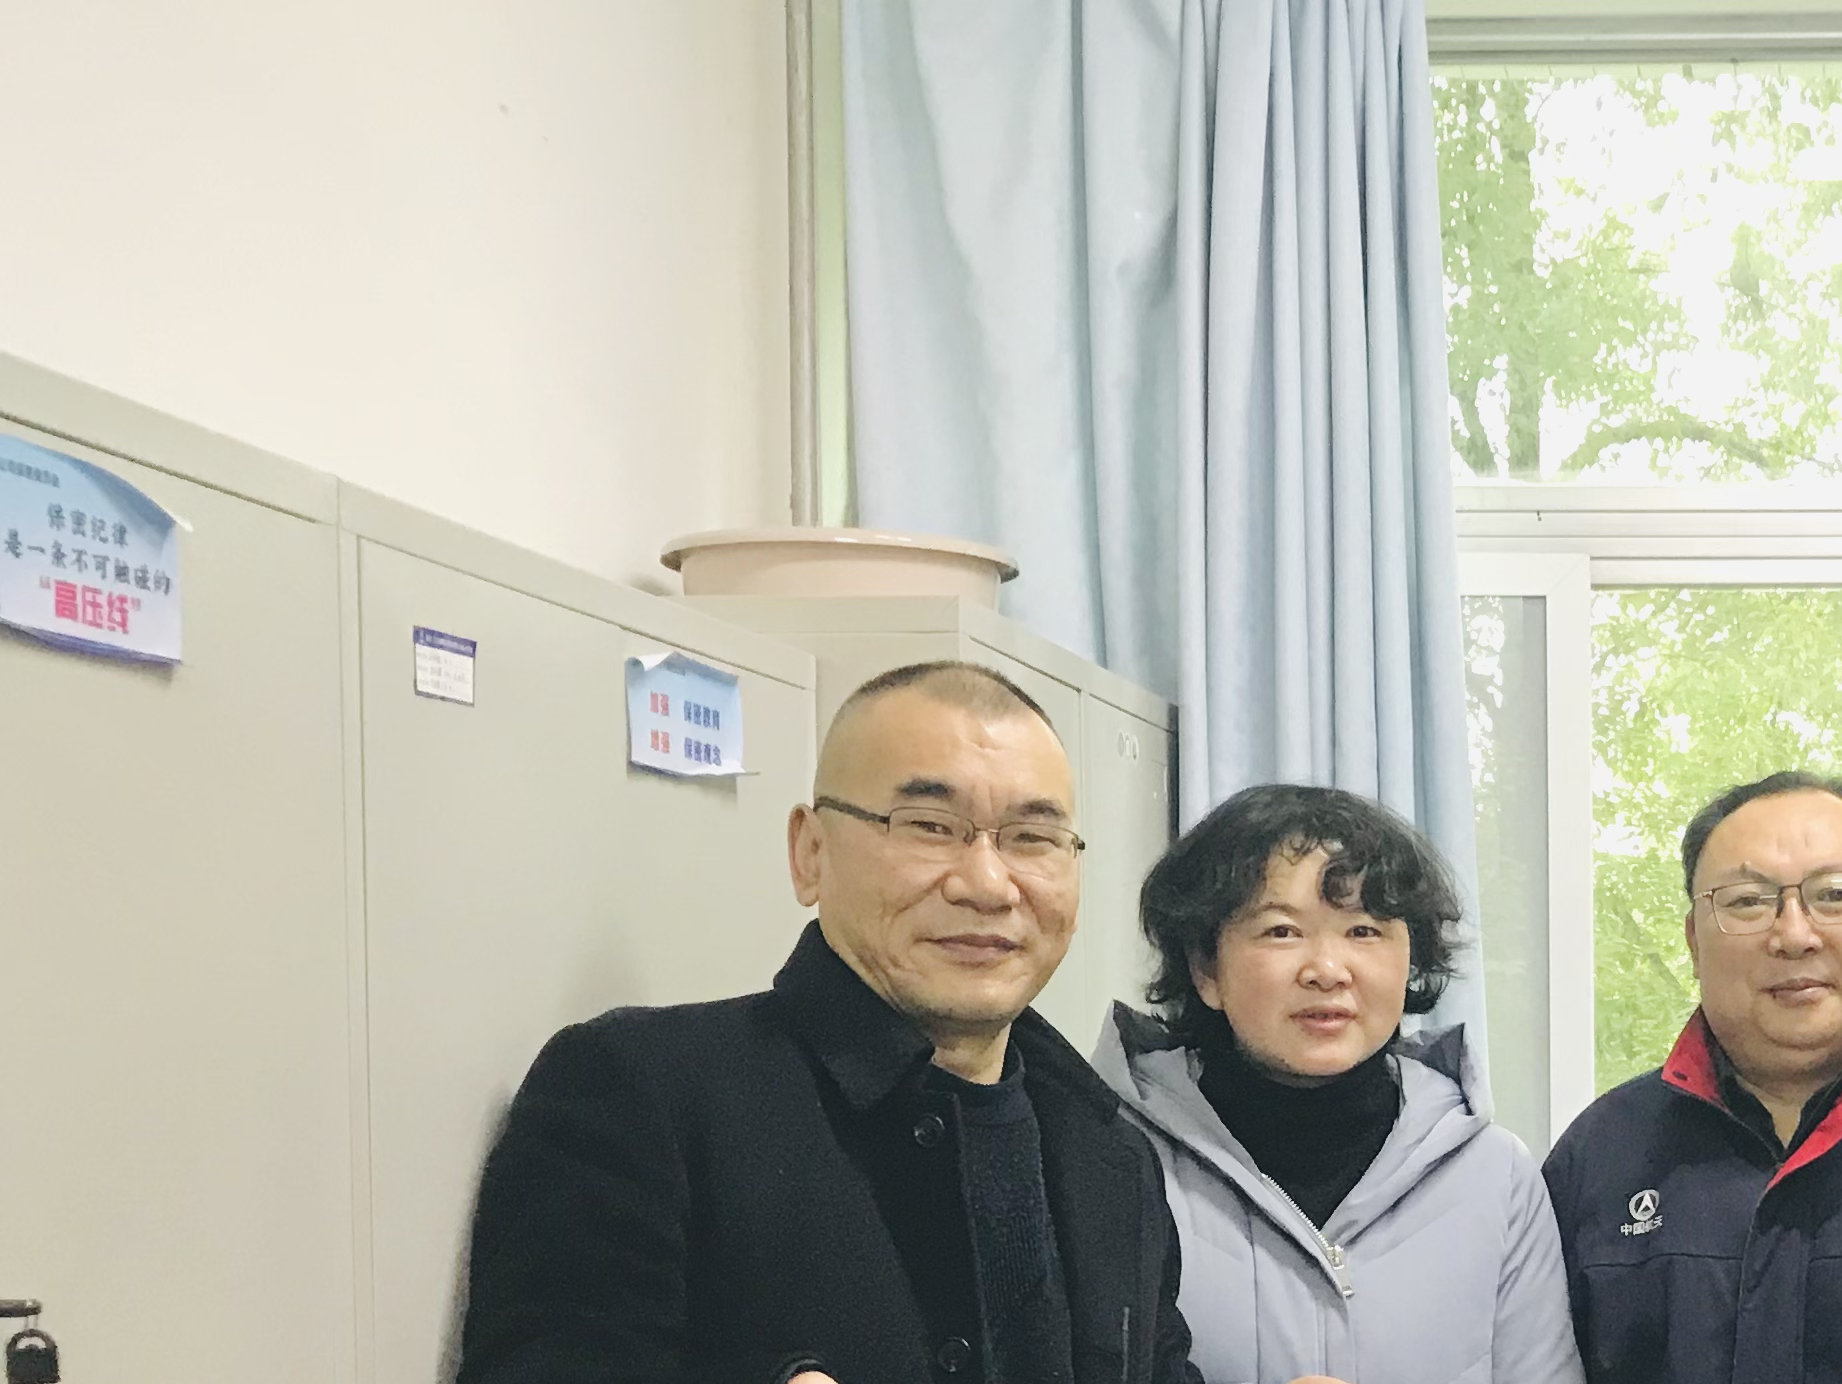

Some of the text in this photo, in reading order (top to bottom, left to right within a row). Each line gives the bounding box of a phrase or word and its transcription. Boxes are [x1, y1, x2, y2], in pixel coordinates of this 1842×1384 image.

[48, 502, 128, 549] 保密纪律
[5, 528, 171, 595] 是一条不可触碰的
